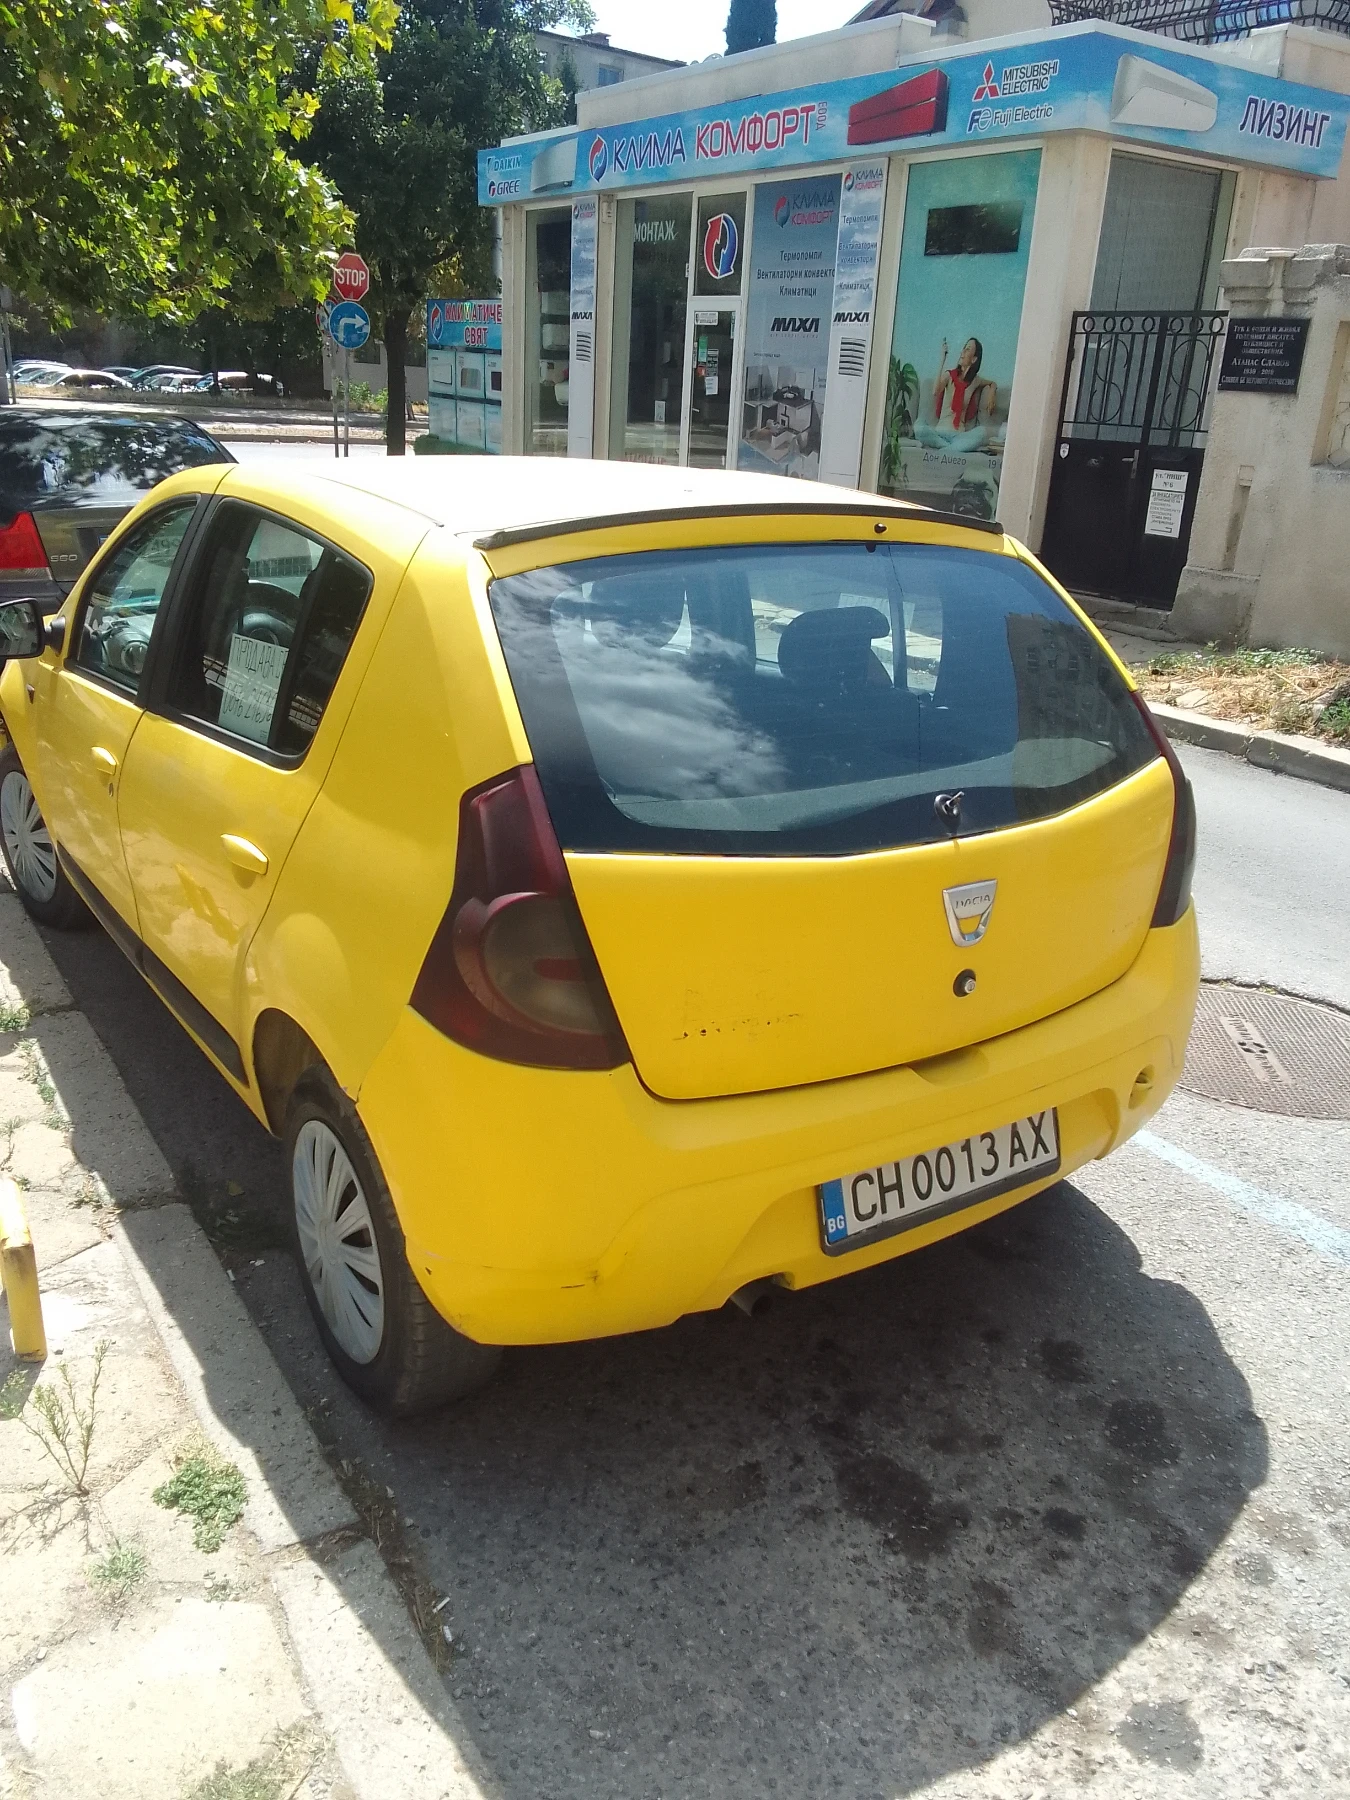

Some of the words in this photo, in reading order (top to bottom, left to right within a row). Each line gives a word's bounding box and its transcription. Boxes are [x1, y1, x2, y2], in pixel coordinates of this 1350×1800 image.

[1003, 60, 1059, 82] MITSUBISHI
[1002, 77, 1049, 95] ELECTRIC
[993, 109, 1012, 127] Fuji
[1014, 104, 1053, 121] Electric
[1239, 97, 1330, 148] ЛИЗИНГ
[613, 128, 686, 172] КЛИМА
[695, 104, 816, 160] КОМФОРТ
[494, 156, 521, 171] DAIKIN
[855, 168, 884, 181] КЛИМА
[497, 180, 520, 195] GREE
[791, 189, 835, 209] КЛИМА
[634, 220, 676, 242] МОНТАЖ
[780, 250, 822, 263] Термопомпи
[337, 267, 366, 287] STOP
[757, 269, 803, 280] Вентилаторни
[780, 285, 817, 298] Климатици
[770, 317, 820, 332] MAXA
[833, 312, 869, 323] MAXA
[464, 327, 489, 346] СВЯТ
[923, 452, 939, 462] Дон
[941, 454, 967, 466] Диего
[50, 554, 78, 562] S60
[851, 1162, 905, 1223] CH
[911, 1131, 1000, 1201] 0013
[1009, 1110, 1051, 1169] AX
[826, 1214, 847, 1233] BG
